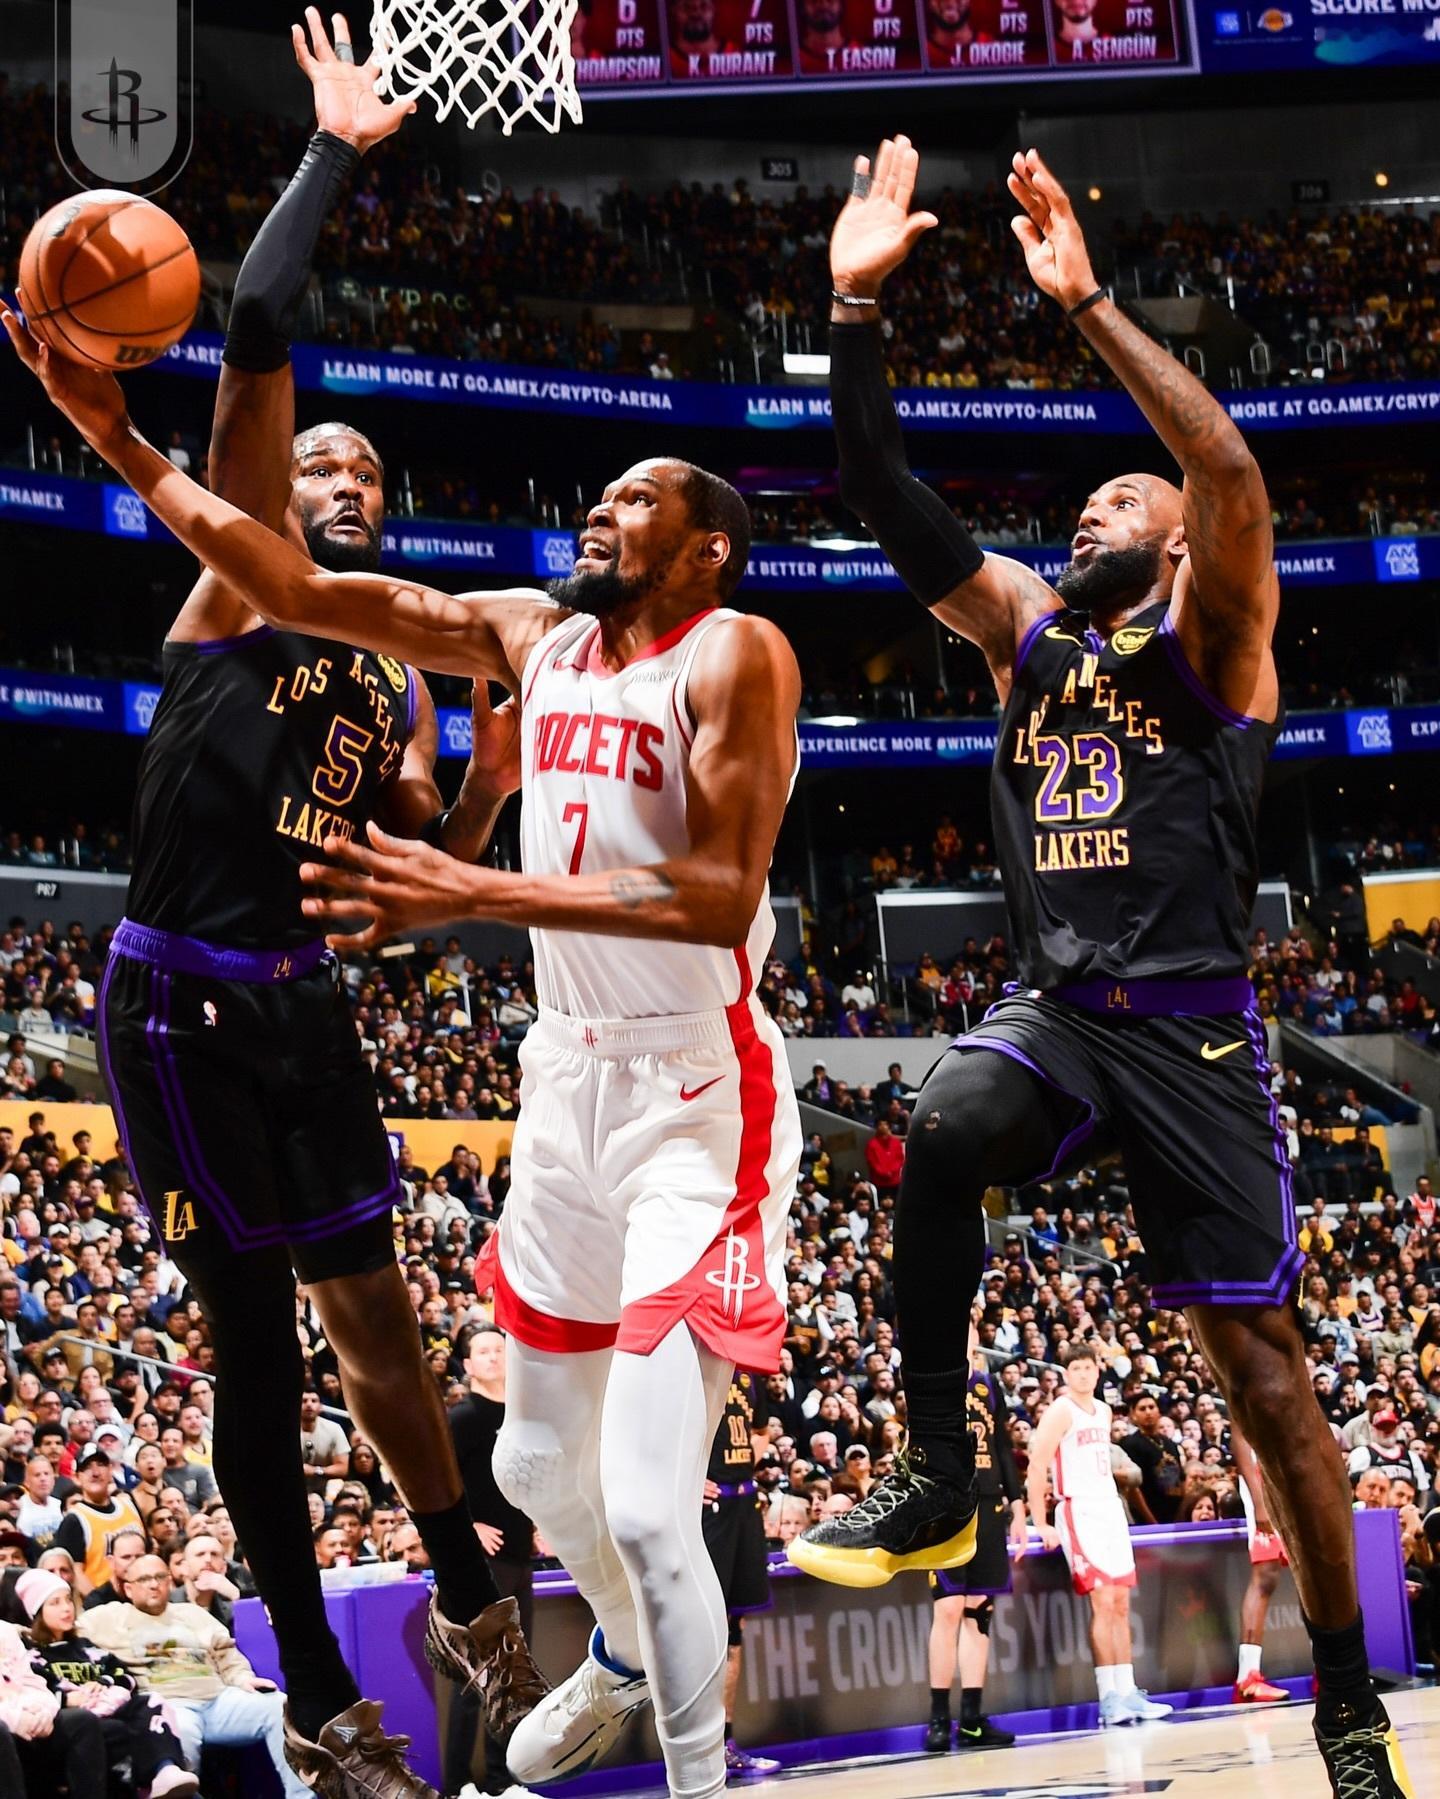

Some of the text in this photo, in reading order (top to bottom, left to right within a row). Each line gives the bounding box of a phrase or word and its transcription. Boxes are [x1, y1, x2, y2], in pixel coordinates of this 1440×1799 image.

[873, 17, 900, 39] PTS
[1000, 12, 1027, 33] PTS
[1125, 7, 1153, 28] PTS
[616, 28, 644, 48] PTS
[745, 23, 773, 43] PTS
[709, 52, 776, 75] DURANT
[842, 46, 896, 72] EASON
[969, 40, 1025, 64] OKOGIE
[577, 56, 661, 81] HOMPSON
[323, 360, 381, 382] LEARN
[386, 367, 435, 388] MORE
[440, 371, 460, 390] AT
[748, 398, 1097, 421] LEARN MO O.AMEX/CRYPTO-ARENA
[1229, 391, 1440, 419] MORE AT GO.AMEX/CRYP
[759, 561, 817, 577] BETTER
[821, 561, 900, 578] #WITHAM
[266, 657, 333, 716] LOS
[1060, 653, 1165, 755] ANELES
[1410, 721, 1440, 737] EXP
[800, 736, 887, 753] EXPERIENCE
[891, 736, 933, 752] MORE
[311, 714, 375, 807] 5
[1032, 732, 1124, 823] 23
[562, 802, 588, 876] 7
[1034, 828, 1130, 872] LAKERS
[1107, 985, 1131, 1009] LAL
[162, 1190, 200, 1241] LA
[741, 1610, 820, 1704] THE
[827, 1604, 931, 1694] CROW
[1022, 1593, 1144, 1670] YOUS
